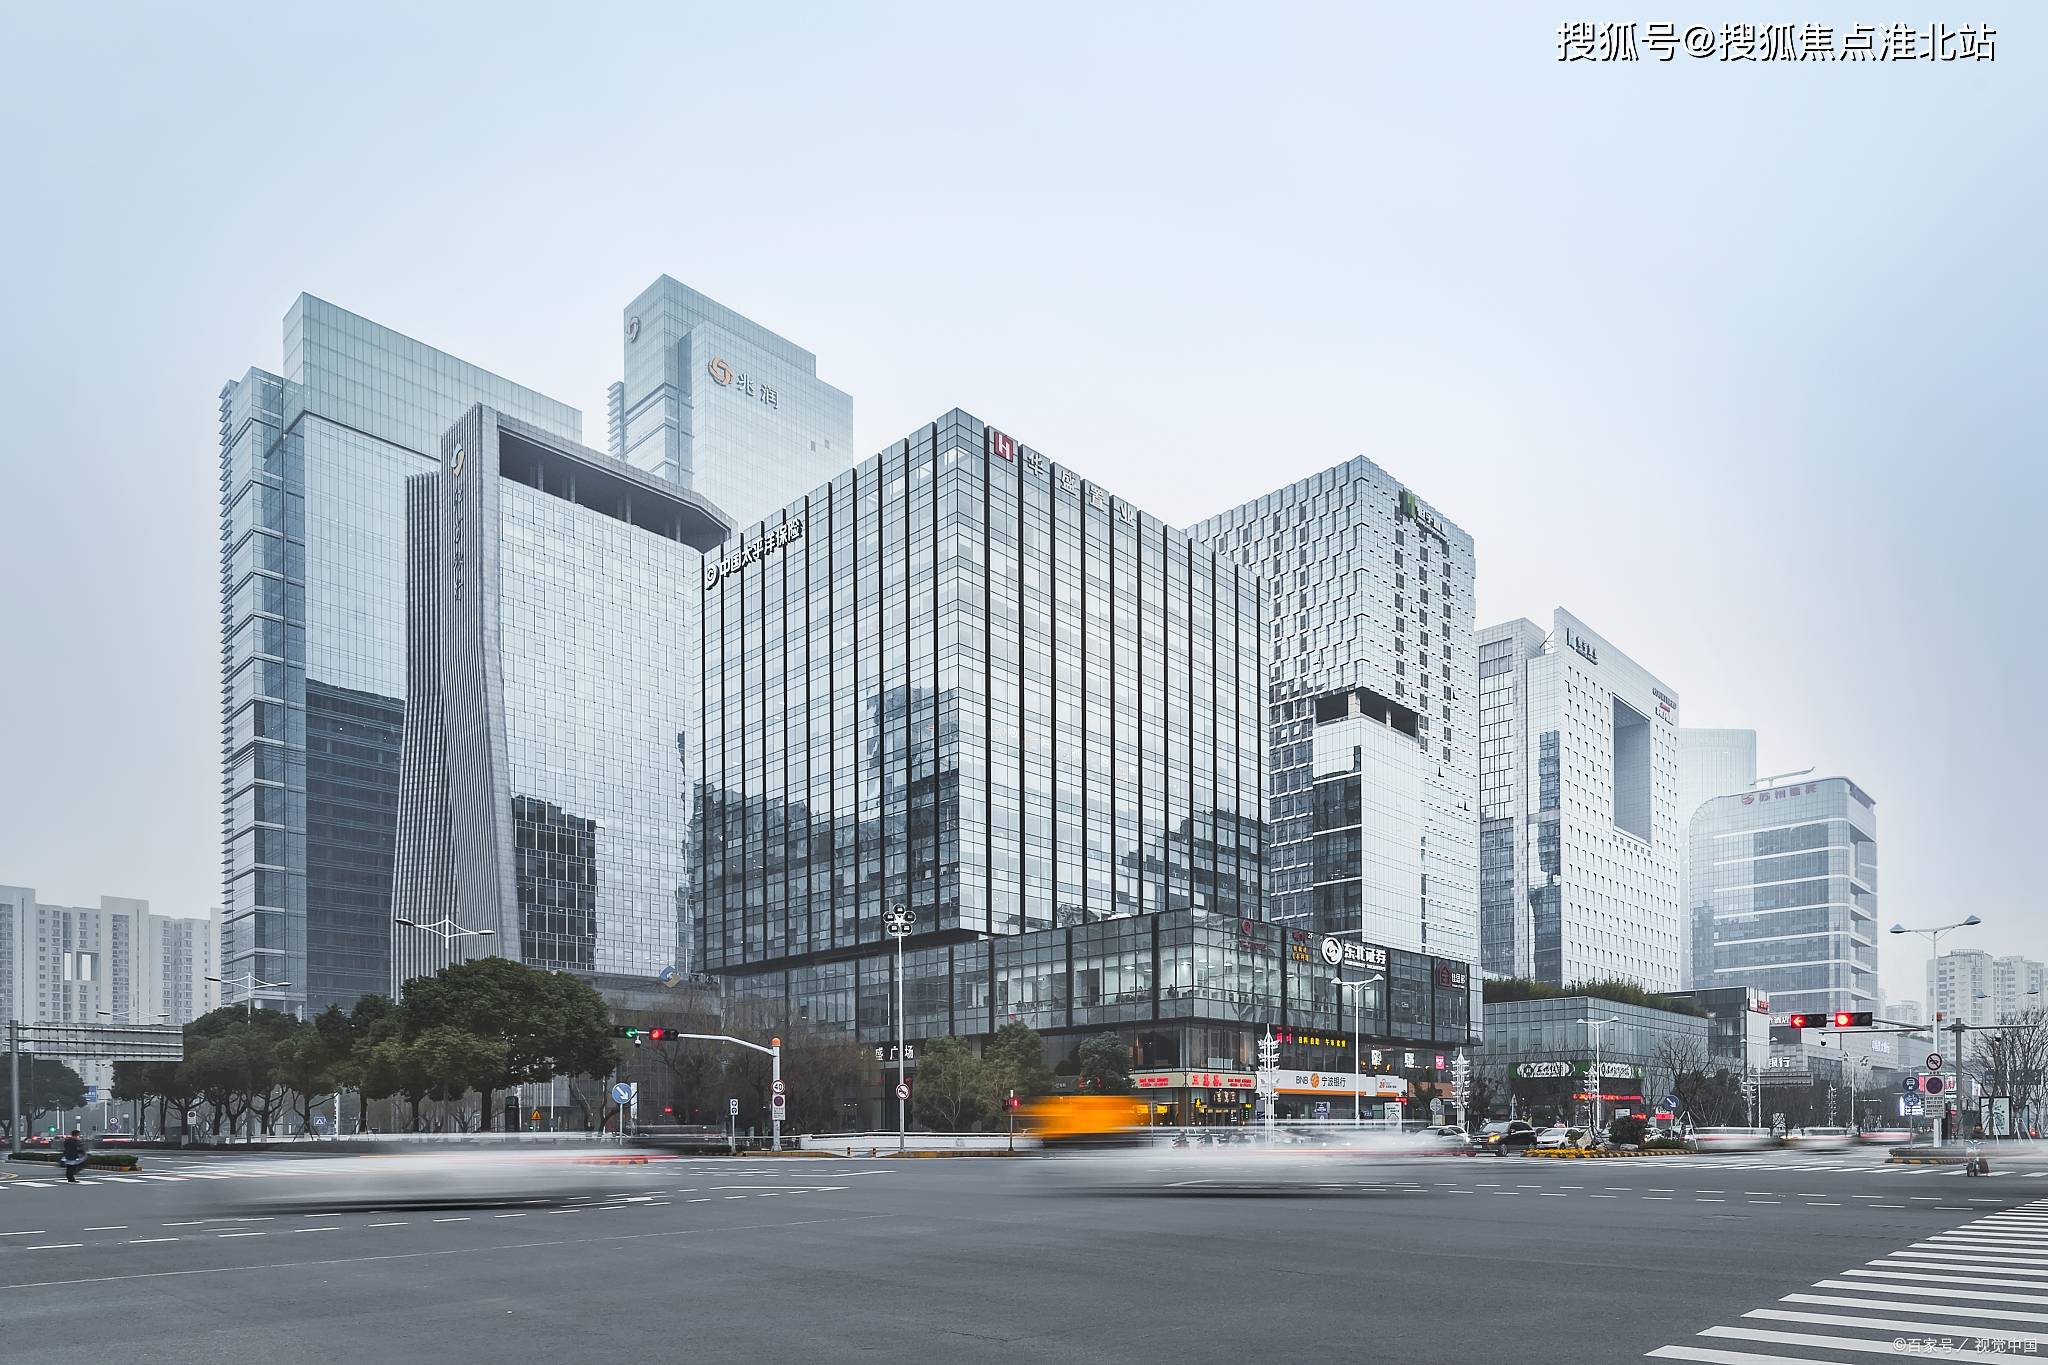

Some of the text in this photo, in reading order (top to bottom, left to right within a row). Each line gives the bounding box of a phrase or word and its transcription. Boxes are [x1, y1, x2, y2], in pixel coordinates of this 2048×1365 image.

[736, 372, 779, 409] 兆润
[719, 518, 804, 578] 中国太平洋保险
[1343, 943, 1387, 965] 东北证券
[1321, 1075, 1346, 1088] 宁波银行
